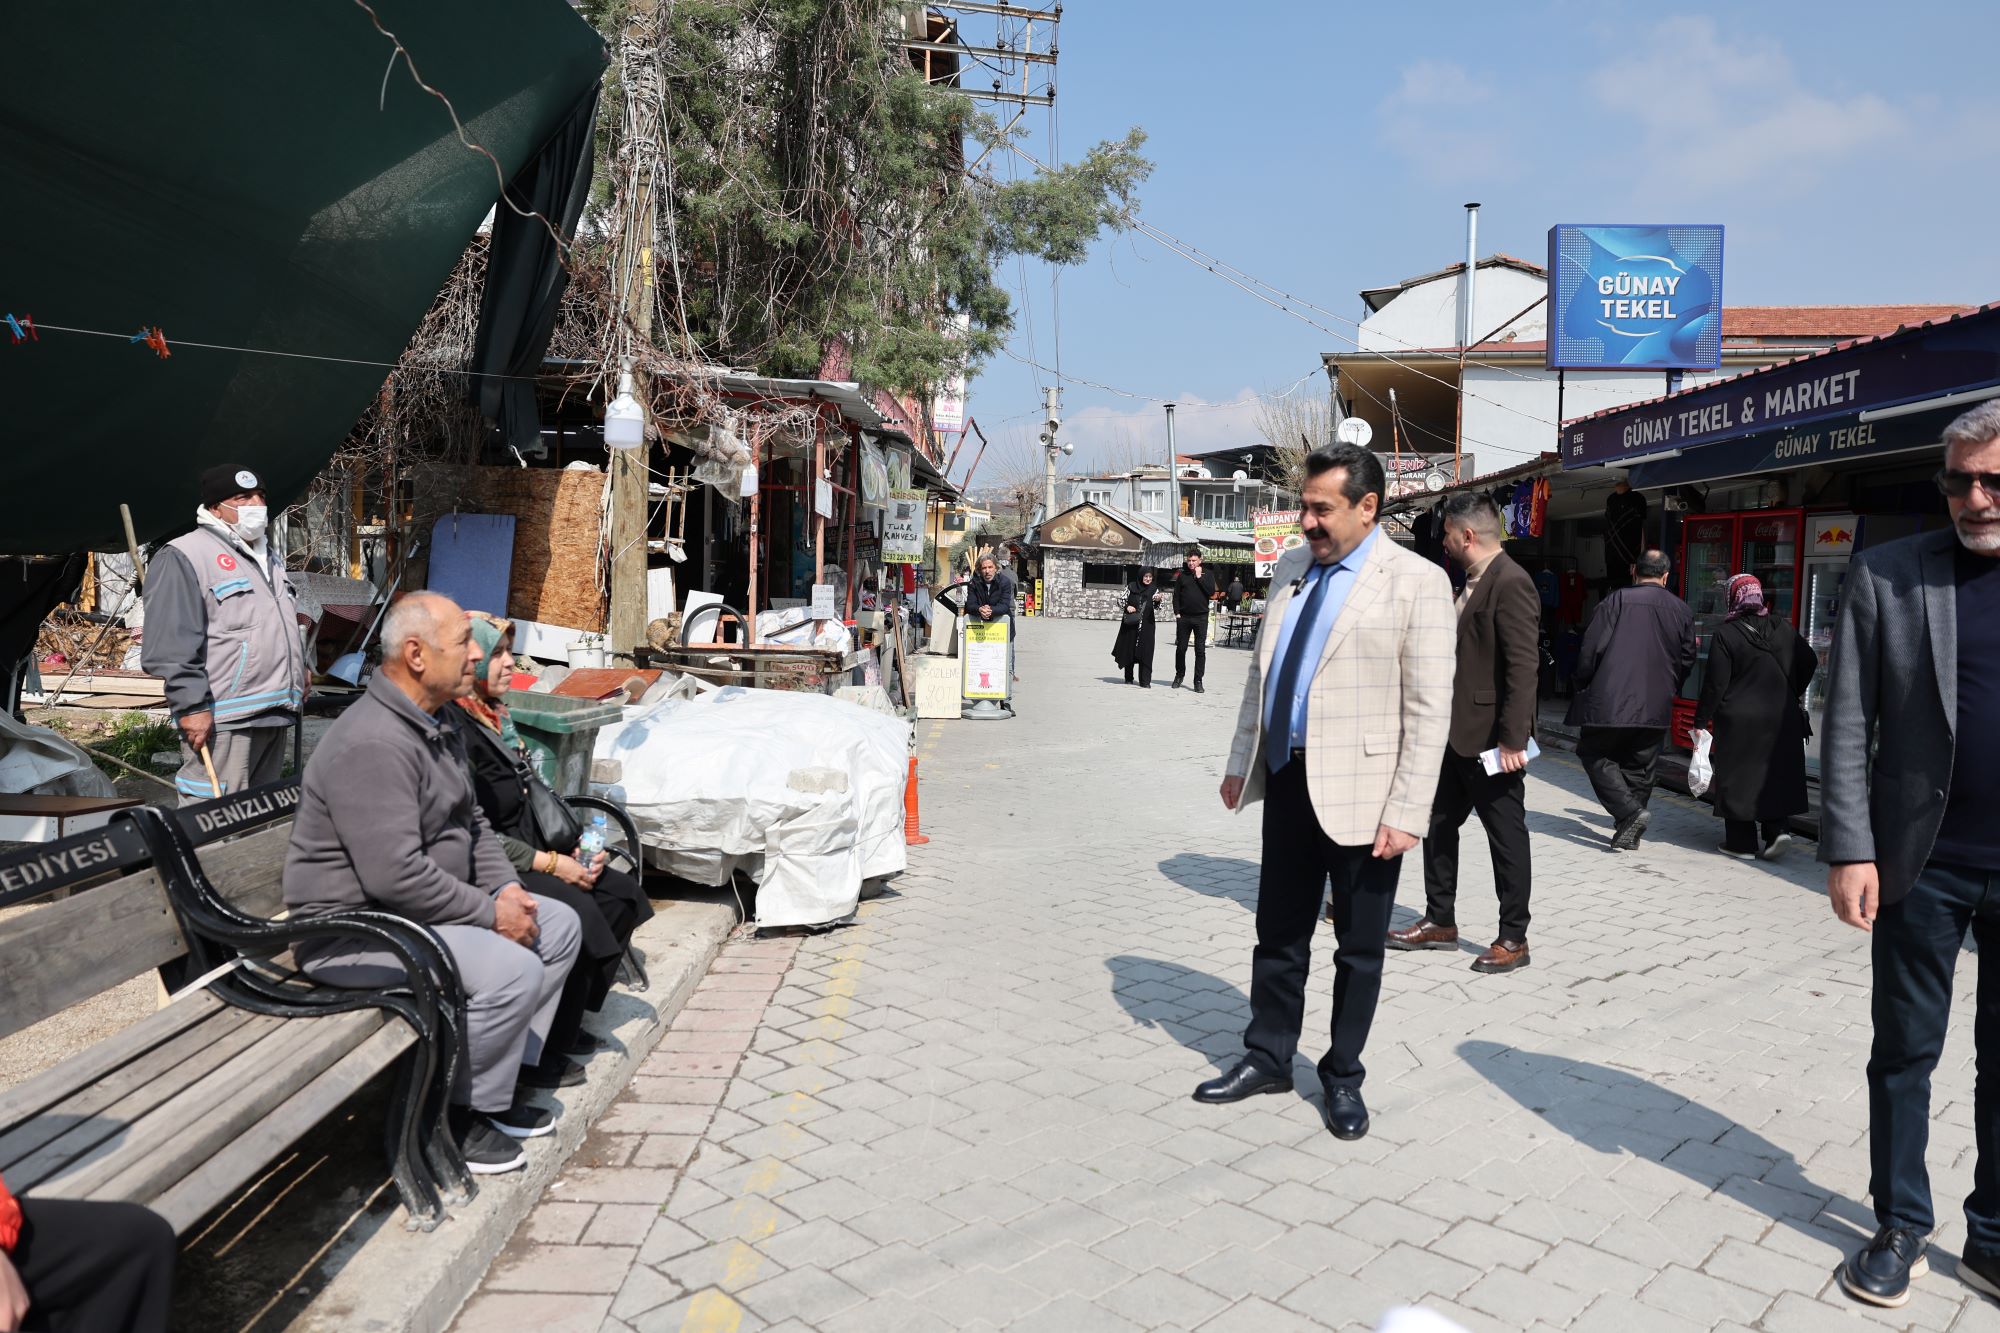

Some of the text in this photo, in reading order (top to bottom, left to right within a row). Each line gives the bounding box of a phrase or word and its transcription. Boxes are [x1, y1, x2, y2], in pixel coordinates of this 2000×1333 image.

[1598, 272, 1680, 295] GÜNAY
[1600, 299, 1677, 319] TEKEL
[1623, 369, 1861, 449] GÜNAY TEKEL & MARKET
[1573, 432, 1585, 444] EGE
[1775, 423, 1877, 460] GÜNAY TEKEL
[1573, 445, 1584, 456] EFE
[1387, 457, 1427, 471] DENİZ
[1385, 471, 1427, 479] RESAURANT
[195, 791, 274, 833] DENİZLİ
[0, 833, 118, 895] EDİYESİ
